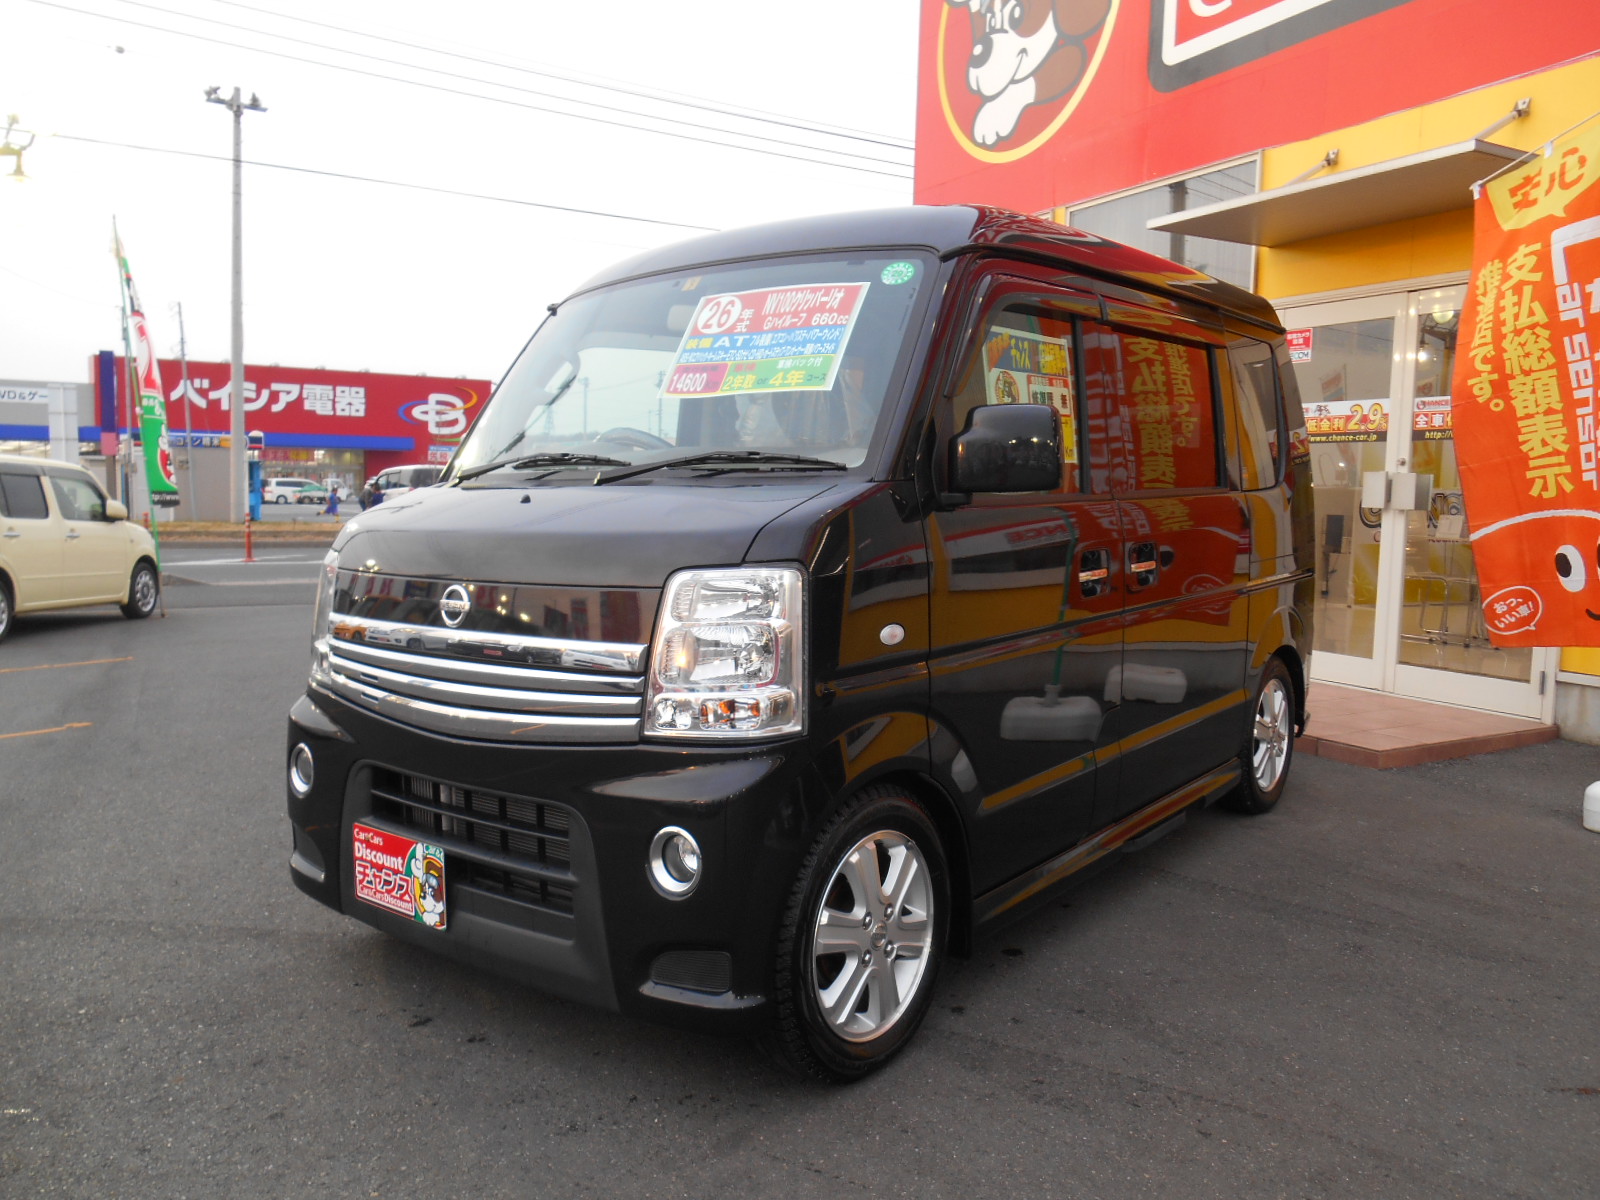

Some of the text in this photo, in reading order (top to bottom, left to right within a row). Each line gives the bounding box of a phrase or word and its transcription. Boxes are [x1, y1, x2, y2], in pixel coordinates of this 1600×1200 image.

[1508, 146, 1587, 214] 安心
[701, 300, 735, 331] 26
[811, 313, 849, 326] 660cc
[713, 335, 750, 348] AT
[1467, 259, 1505, 412] 推進店です。
[669, 373, 707, 392] 14600
[770, 370, 804, 387] 4年
[1500, 242, 1575, 499] 支払総額表示
[170, 378, 366, 417] ベイシア電器
[1307, 417, 1345, 433] 低金利
[354, 841, 404, 872] Discount
